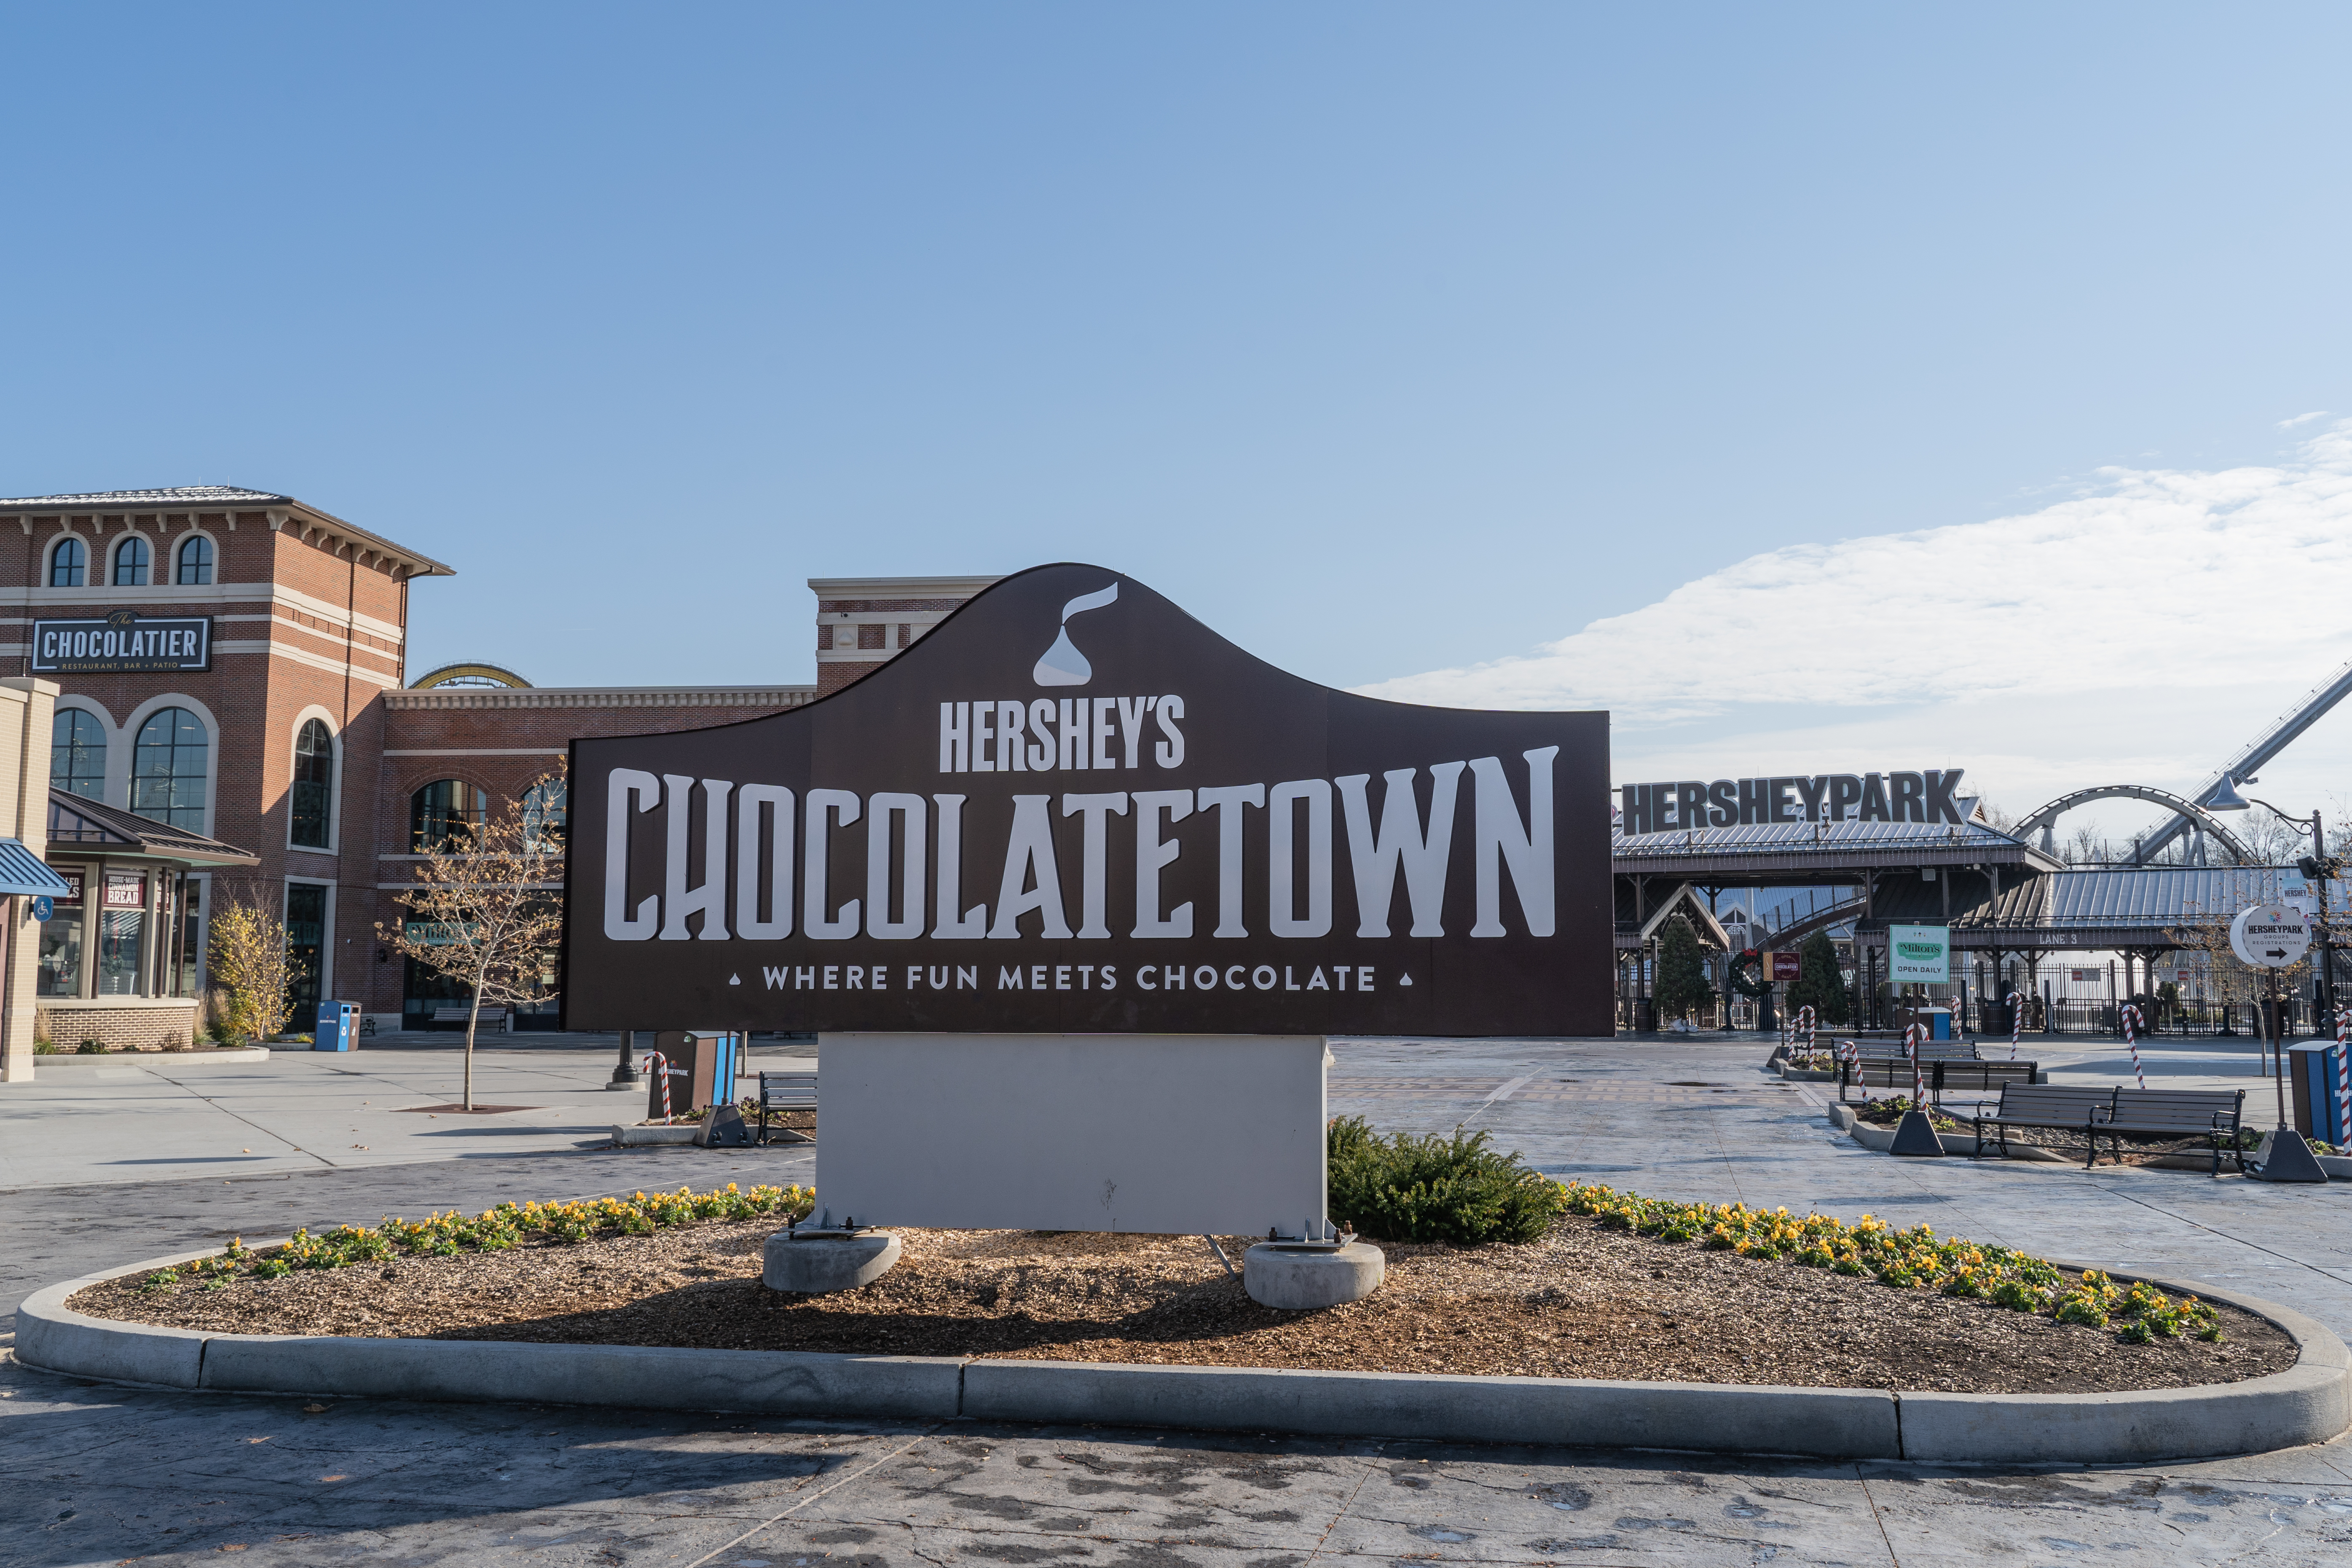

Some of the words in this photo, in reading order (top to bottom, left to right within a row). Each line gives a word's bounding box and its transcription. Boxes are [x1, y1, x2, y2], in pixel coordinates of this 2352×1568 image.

[109, 612, 133, 628] The
[44, 630, 197, 658] CHOCOLATIER
[939, 694, 1185, 773] HERSHEY'S
[2230, 770, 2257, 784] HERSHEY
[1622, 769, 1964, 837] HERSHEYPARK
[604, 745, 1559, 941] CHOCOLATETOWN
[109, 876, 139, 884] HOUSE-MADE
[108, 883, 139, 892] CINNAMON
[107, 890, 139, 904] BREAD
[2248, 925, 2304, 934] HERSHEYPARK
[2039, 934, 2065, 944] LANE
[2071, 934, 2077, 944] 3
[1899, 943, 1940, 953] Milton's
[763, 966, 887, 990] WHERE
[907, 965, 977, 989] FUN
[998, 965, 1116, 990] MEETS
[1137, 965, 1374, 991] CHOCOLATE
[658, 1068, 688, 1076] HSHEYPARK
